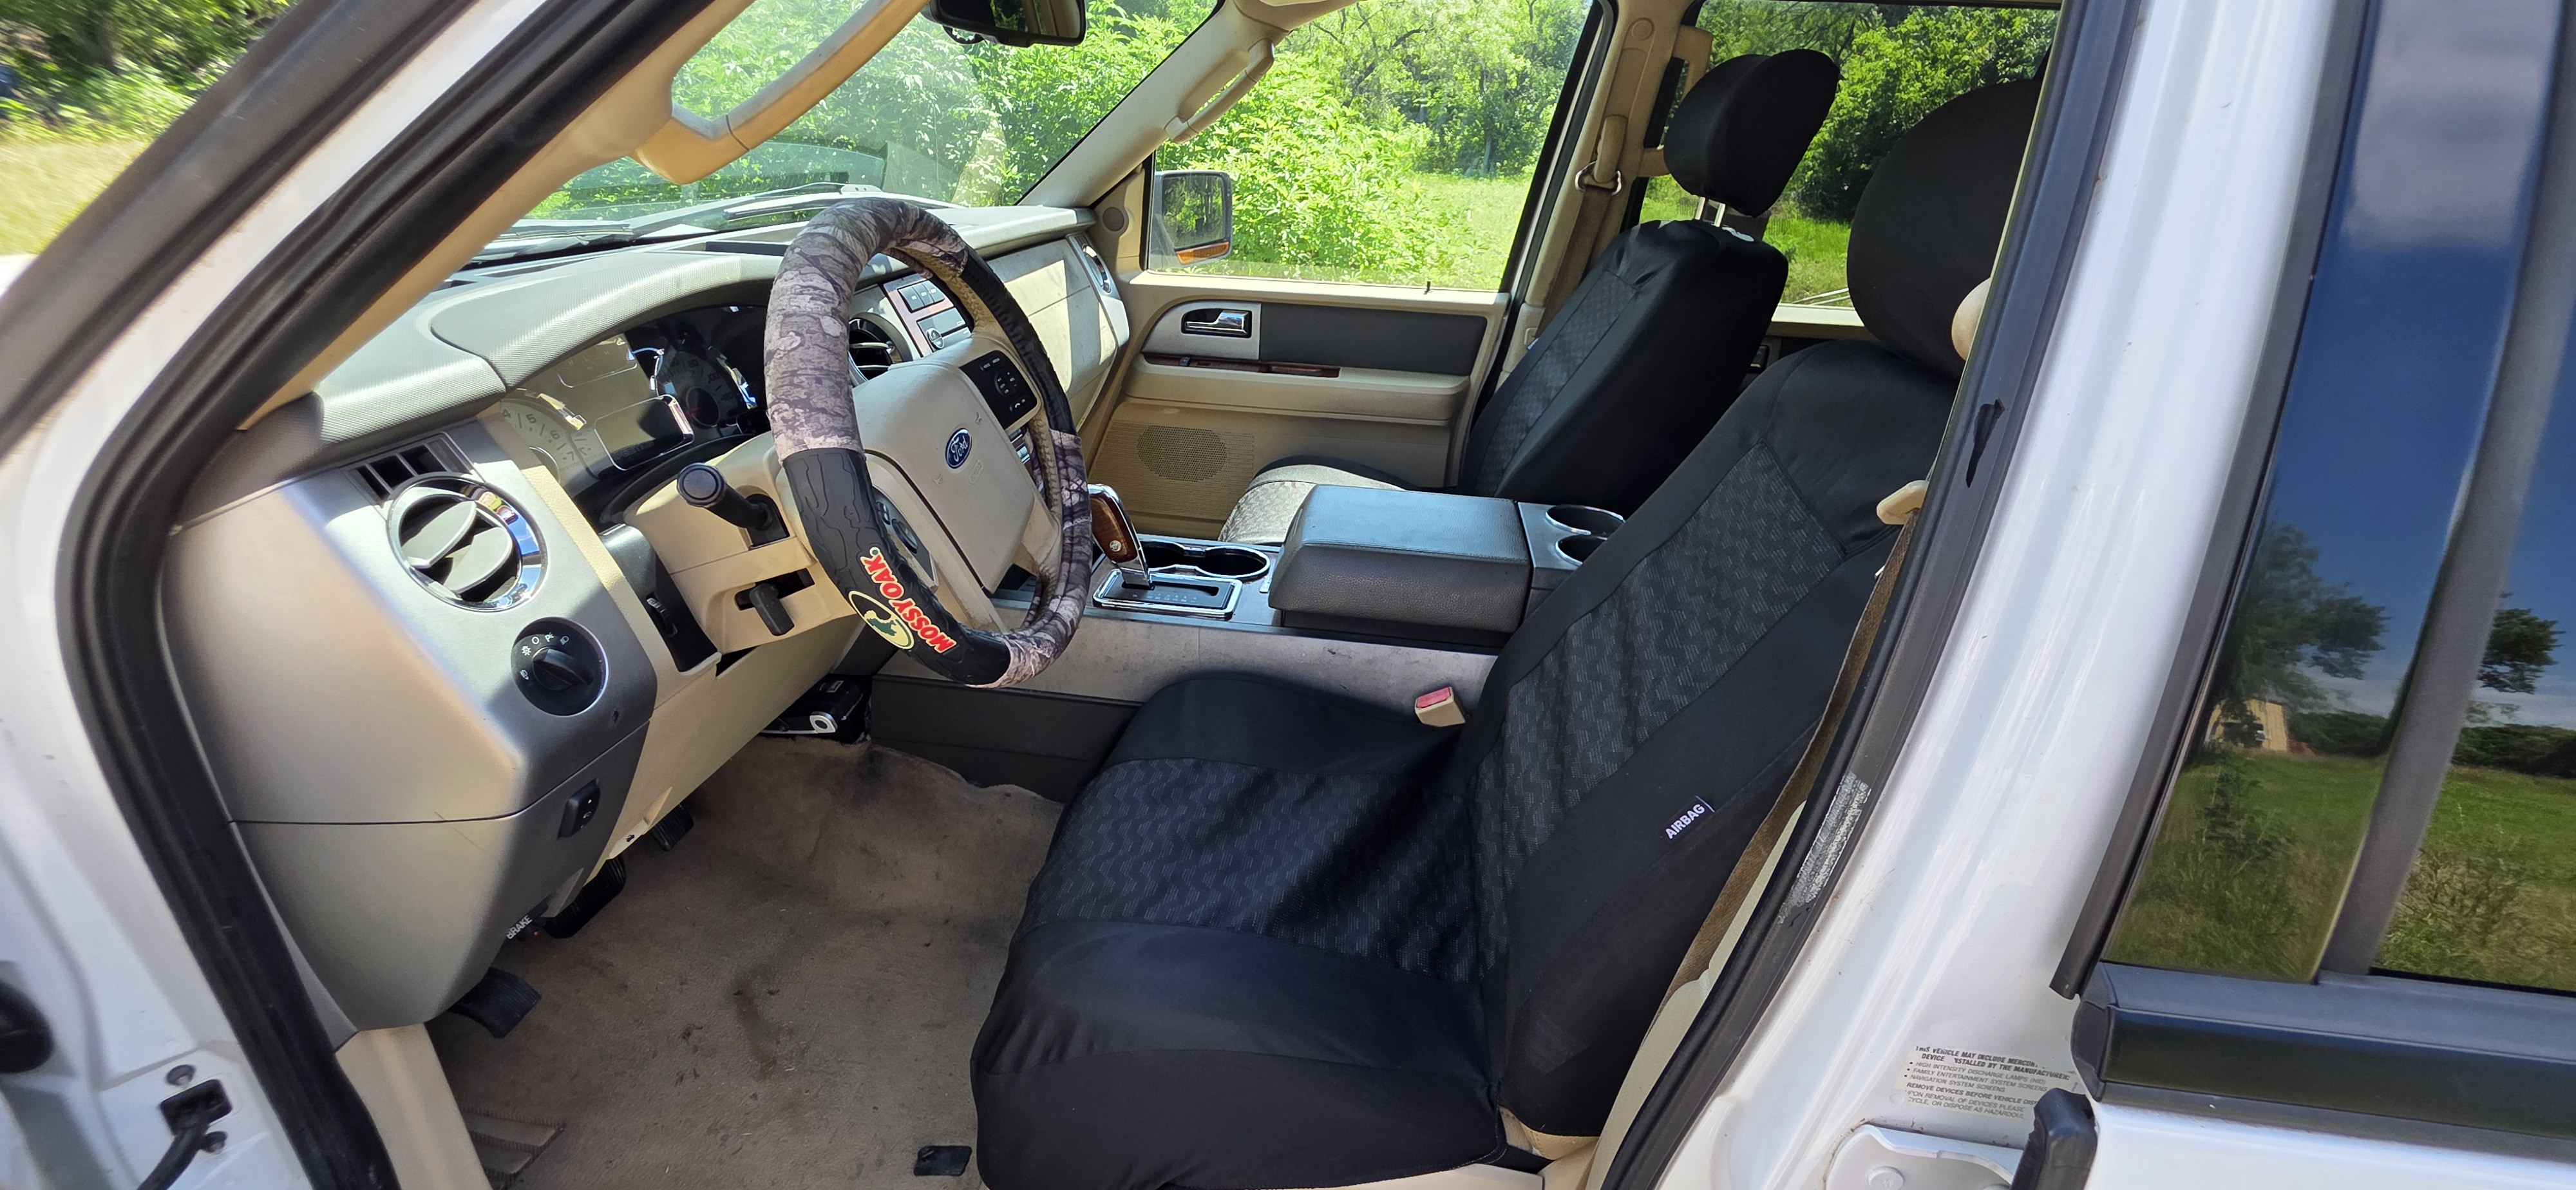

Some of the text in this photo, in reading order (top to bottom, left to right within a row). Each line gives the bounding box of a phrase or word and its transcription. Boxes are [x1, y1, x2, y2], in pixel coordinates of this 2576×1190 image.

[526, 413, 536, 424] 5
[549, 430, 560, 440] 6
[566, 451, 575, 462] 7
[950, 435, 969, 463] Ford
[860, 554, 957, 654] MOSSY OAK
[1665, 804, 1705, 840] AIRBAG
[506, 914, 533, 940] BRAKE
[1933, 1048, 1960, 1057] VEHICLE
[1961, 1051, 1976, 1059] MAY
[1977, 1053, 2006, 1063] INCLUDE
[1913, 1067, 2049, 1091] FAMILY ENTERTAINMENT SYSTEM SCREENS
[1933, 1062, 1966, 1073] INTENSITY
[1967, 1068, 2004, 1078] DISCHARGE
[2005, 1073, 2029, 1082] LAMPS
[1906, 1082, 1935, 1091] REMOVE
[1935, 1086, 1964, 1095] DEVICES
[1965, 1090, 1993, 1099] BEFORE
[1993, 1094, 2023, 1104] VEHICLE
[1910, 1073, 2006, 1093] NAVIGATION SYSTEM SCREENS
[1924, 1093, 1955, 1102] REMOVAL
[1968, 1099, 1998, 1108] DEVICES
[1998, 1104, 2025, 1112] PLEASE
[1943, 1102, 1973, 1111] DISPOSE
